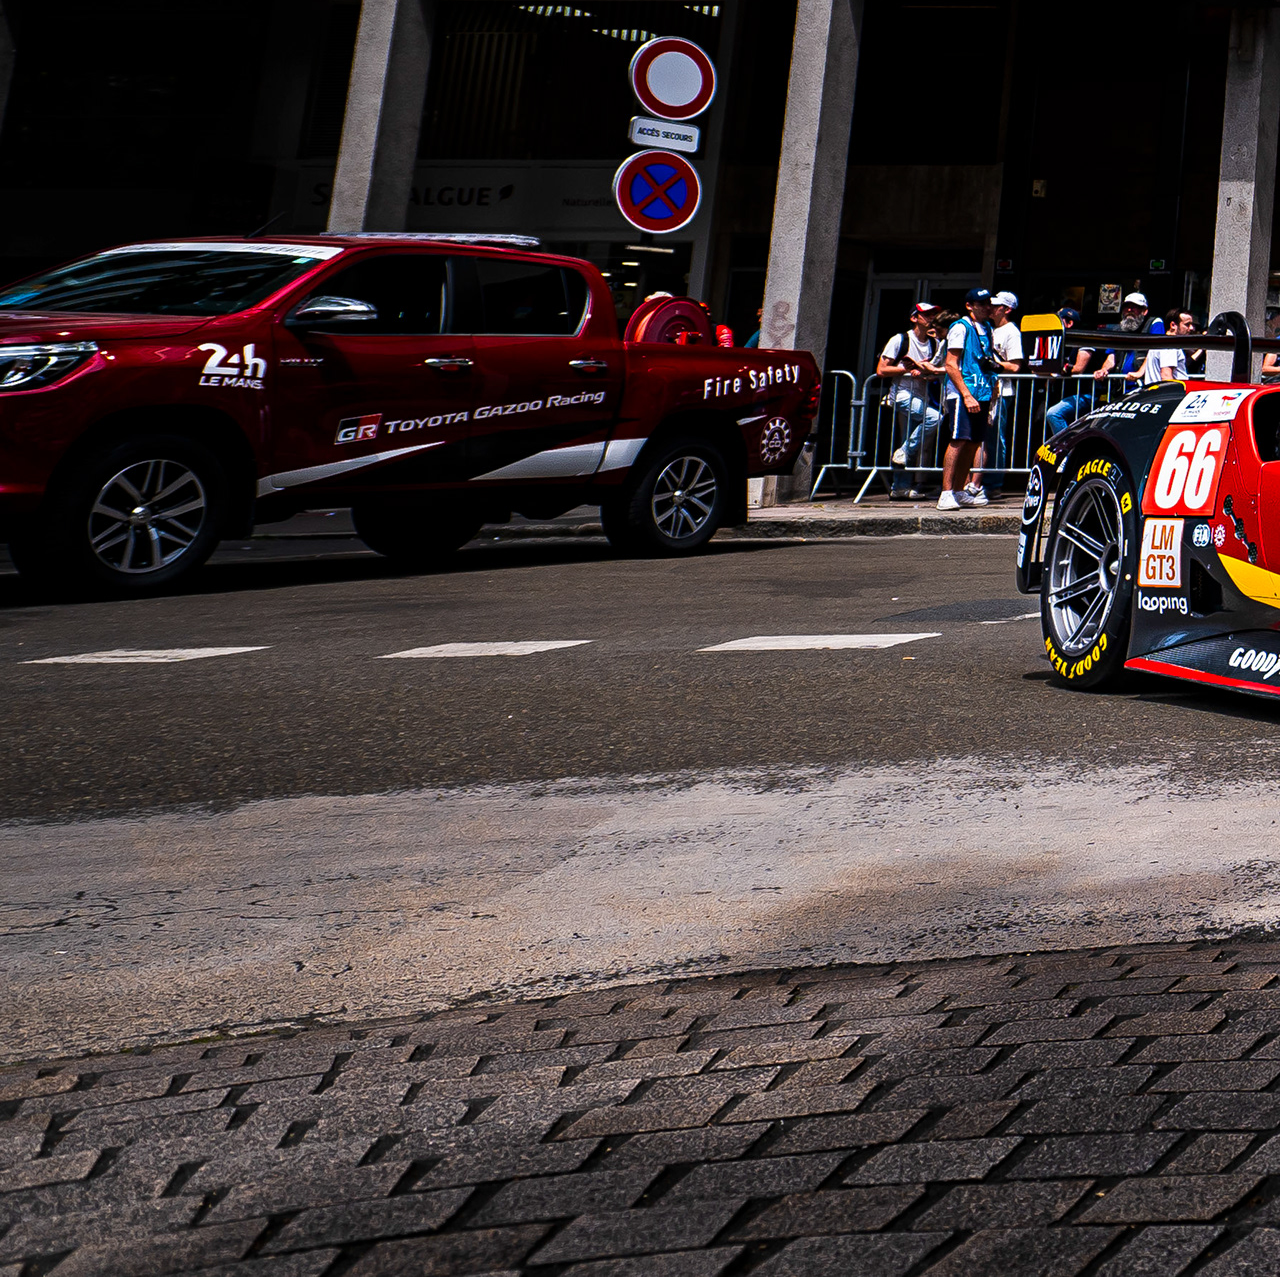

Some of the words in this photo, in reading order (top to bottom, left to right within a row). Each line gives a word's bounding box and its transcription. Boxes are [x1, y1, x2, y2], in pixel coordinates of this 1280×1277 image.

[637, 126, 660, 137] ACCÈS
[662, 131, 693, 143] SECOURS
[1029, 335, 1062, 360] JMW
[199, 375, 221, 387] LE
[222, 377, 263, 389] MANS
[703, 376, 742, 400] Fire
[748, 363, 800, 390] Safety
[336, 424, 376, 443] GR
[384, 411, 469, 434] TOYOTA
[472, 399, 543, 420] GAZOO
[545, 391, 606, 409] Racing
[1076, 458, 1112, 482] EAGLE
[1154, 429, 1222, 510] 66
[1151, 524, 1175, 550] LM
[1145, 553, 1176, 581] GT3
[1138, 590, 1188, 614] looping
[1044, 633, 1108, 680] GOODYEAR
